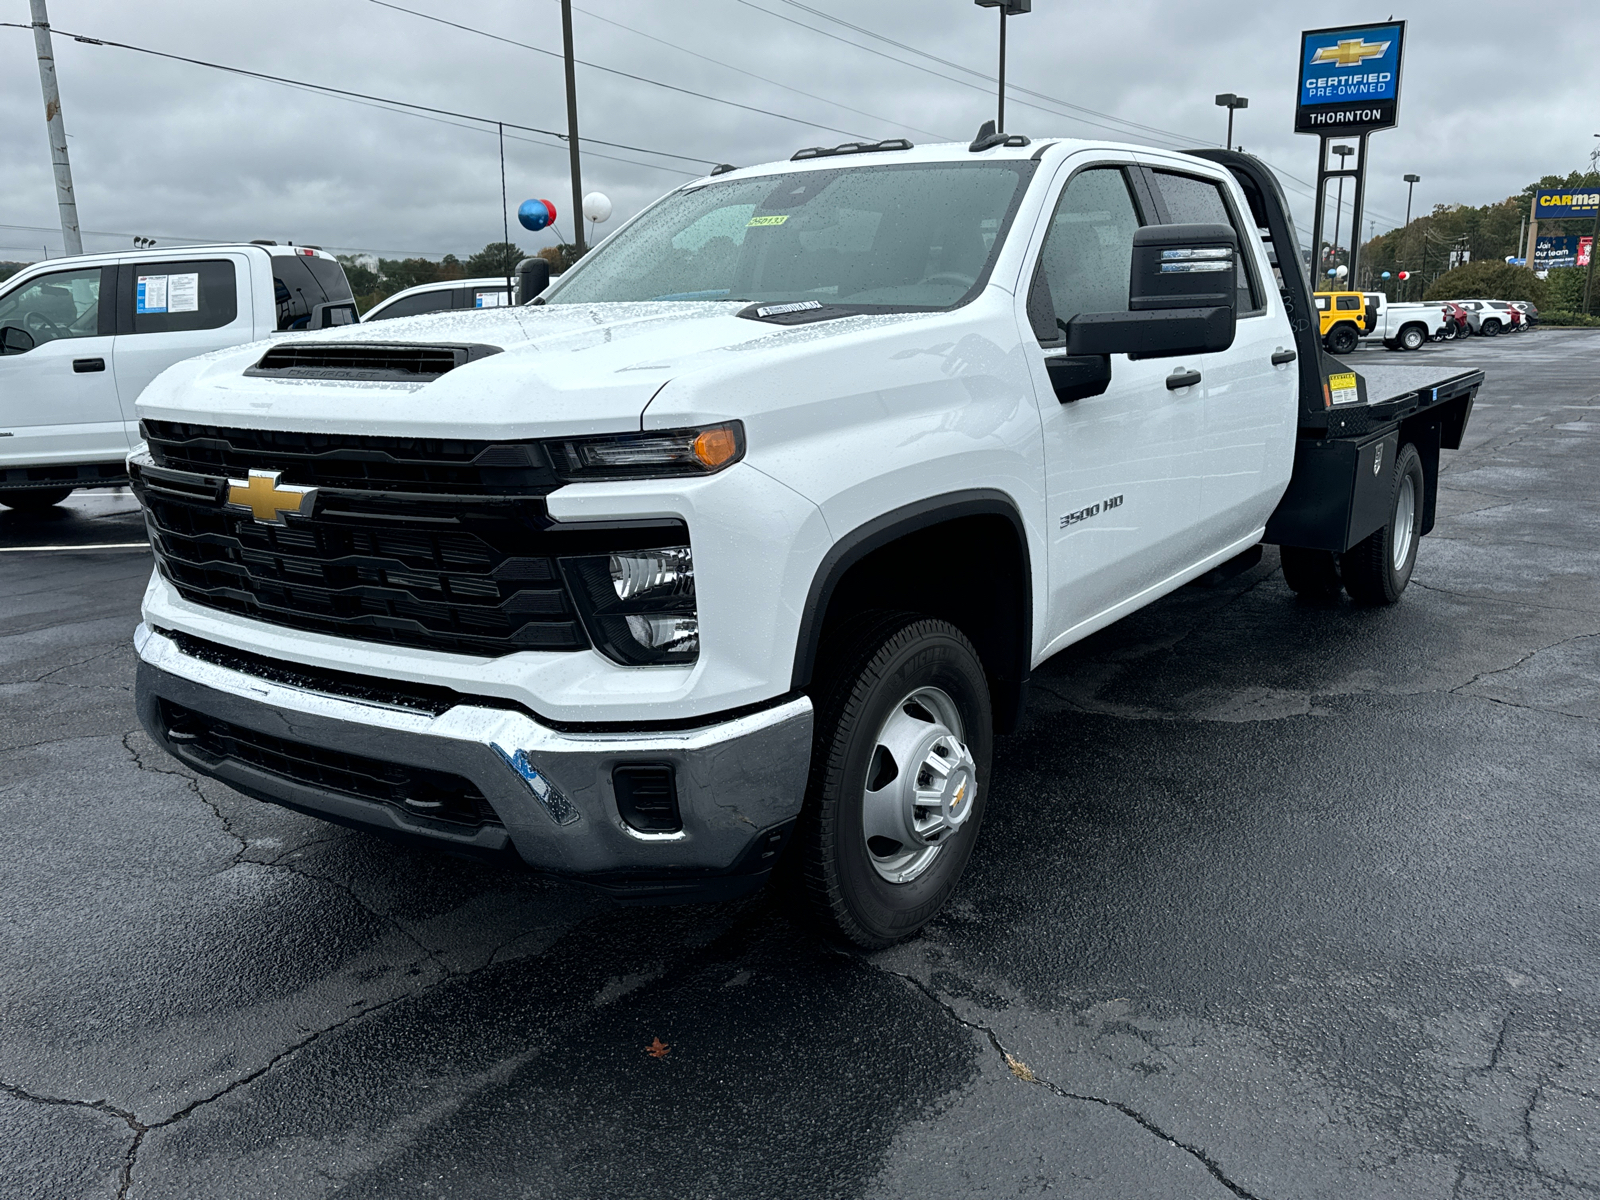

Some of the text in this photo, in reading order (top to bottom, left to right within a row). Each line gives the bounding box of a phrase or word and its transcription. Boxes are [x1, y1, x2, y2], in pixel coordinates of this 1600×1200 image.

[1306, 72, 1391, 88] CERTIFIED
[1309, 83, 1386, 97] PRE-OWNED
[1309, 109, 1381, 125] THORNTON
[1548, 249, 1569, 257] team
[288, 369, 380, 378] CHEVROLET
[1060, 494, 1123, 529] 3500 HD
